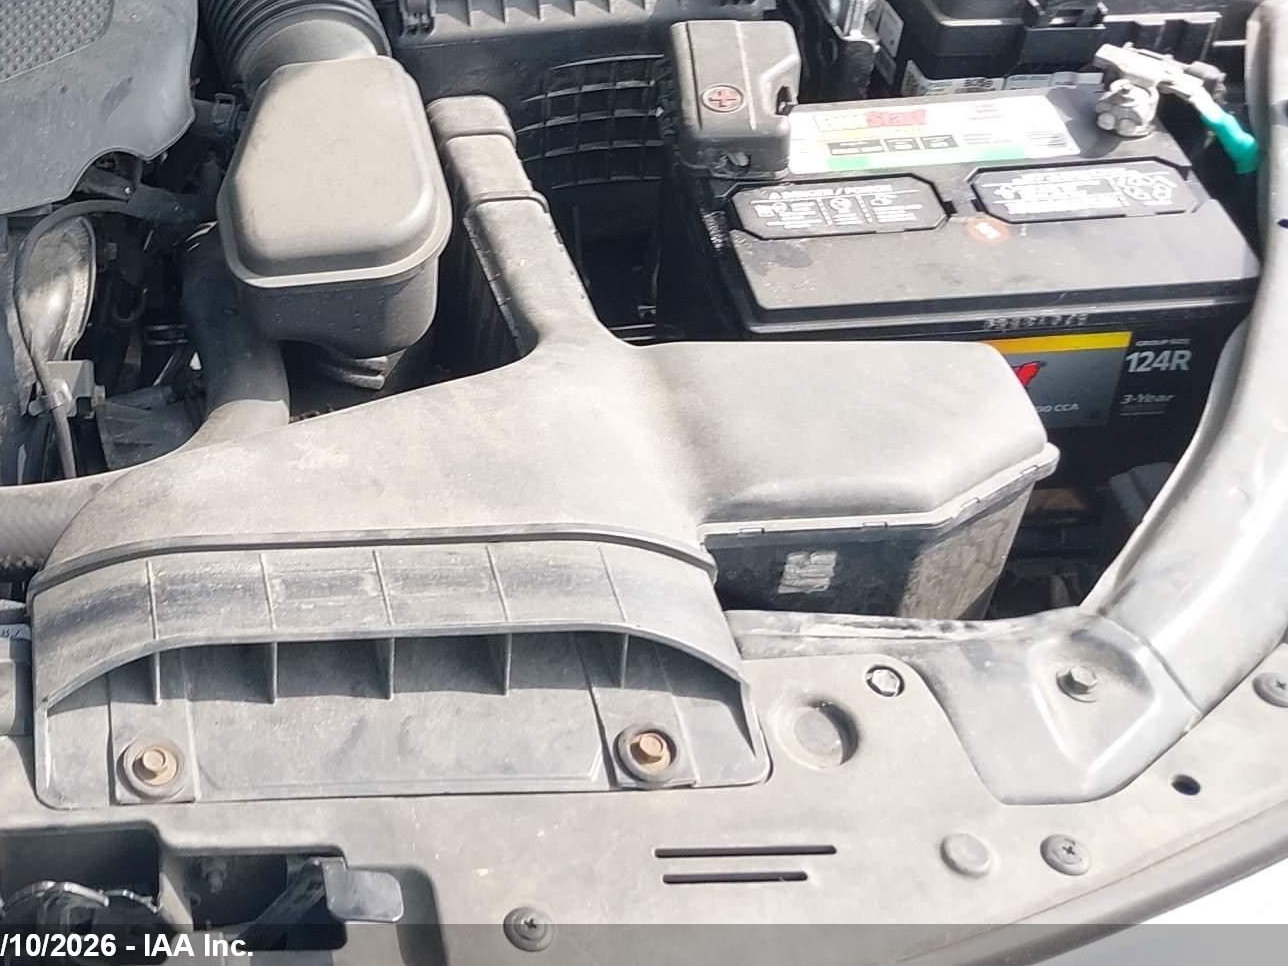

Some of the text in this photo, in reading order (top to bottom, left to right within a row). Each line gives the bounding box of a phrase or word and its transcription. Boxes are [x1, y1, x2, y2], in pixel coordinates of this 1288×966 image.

[1126, 350, 1193, 373] 124R
[1120, 394, 1175, 404] 3-Year
[1054, 402, 1079, 411] CCA
